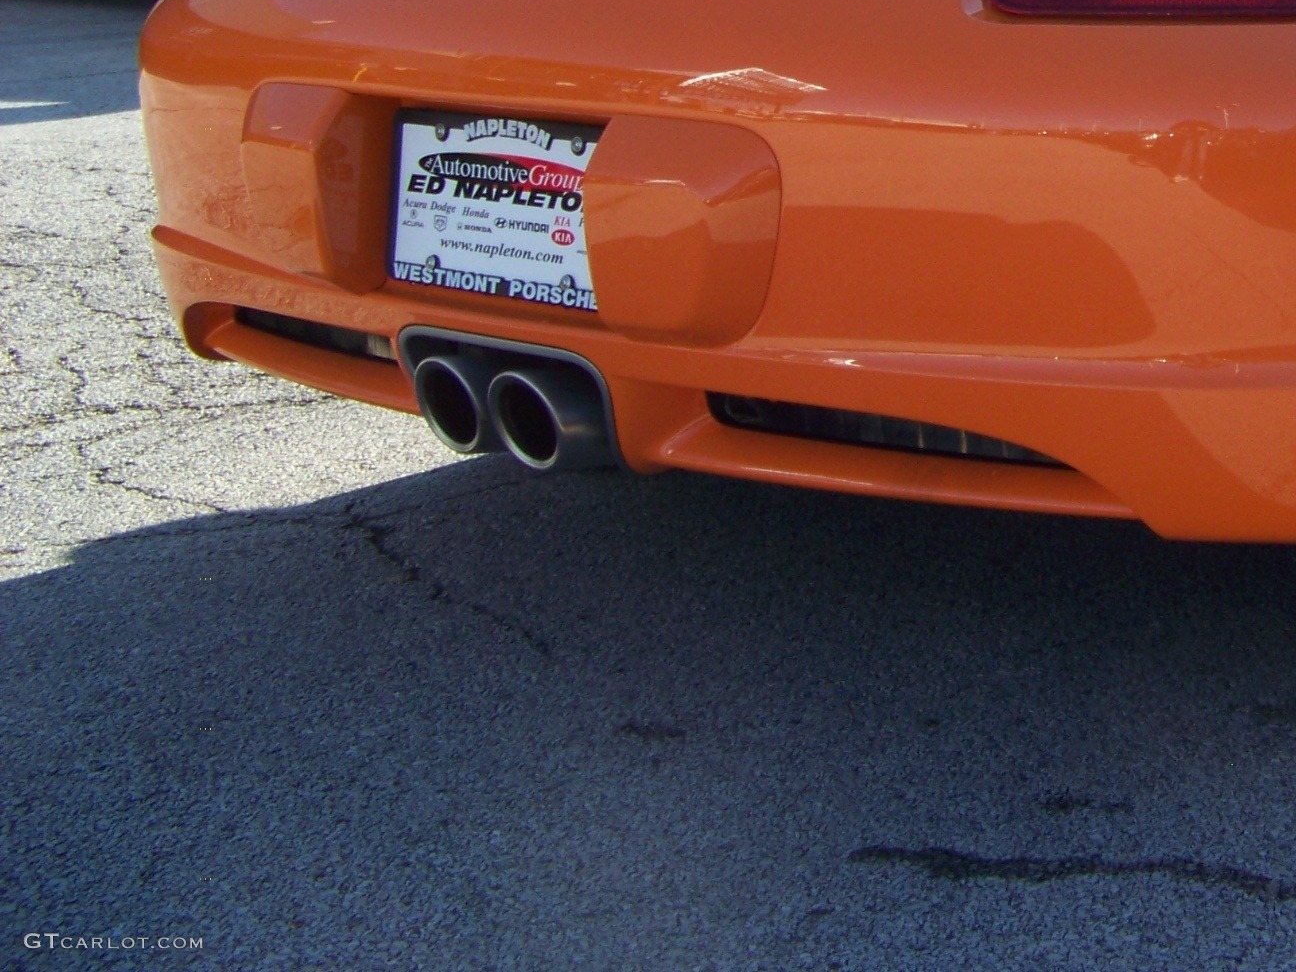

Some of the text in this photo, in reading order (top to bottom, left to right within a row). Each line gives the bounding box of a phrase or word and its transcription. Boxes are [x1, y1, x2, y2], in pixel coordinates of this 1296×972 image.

[463, 118, 551, 150] NAPLETON
[430, 154, 529, 184] Automotive
[407, 173, 584, 213] ED NAPLETO
[403, 197, 427, 209] Acura
[430, 200, 457, 215] Dodge
[462, 206, 490, 219] Honda
[554, 215, 571, 228] KIA
[508, 219, 550, 234] HYUNDAI
[464, 223, 493, 234] HONDA
[554, 231, 572, 244] KIA
[441, 238, 564, 265] www.napleton.com
[394, 262, 501, 295] WESTMONT
